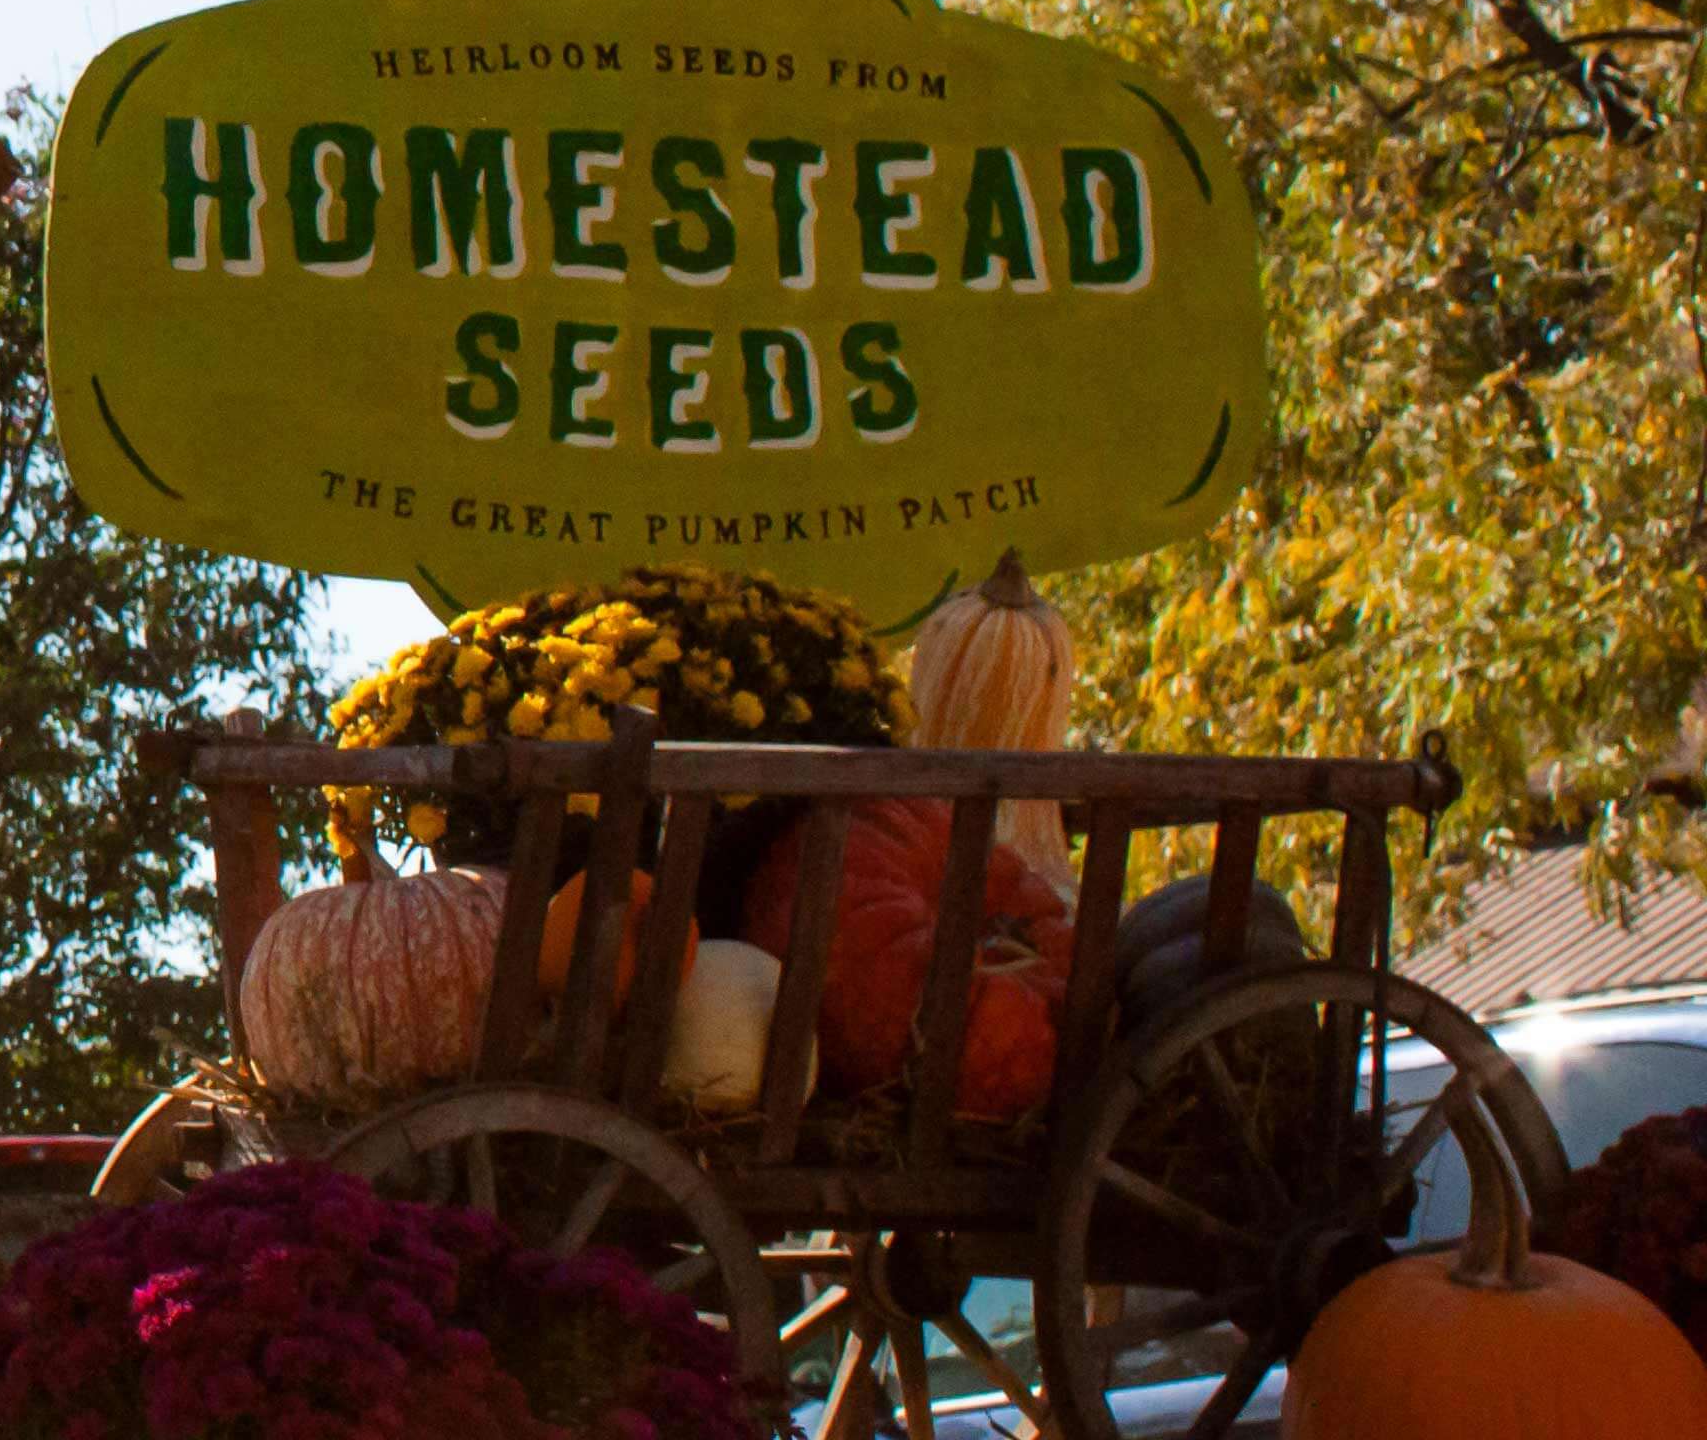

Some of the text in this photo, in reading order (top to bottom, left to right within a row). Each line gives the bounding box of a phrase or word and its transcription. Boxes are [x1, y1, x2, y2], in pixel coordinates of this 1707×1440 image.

[373, 44, 947, 99] HEIRLOOM SEEDS FROM
[160, 116, 1153, 294] HOMESTEAD
[444, 312, 921, 454] SEEDS
[320, 470, 1042, 546] THE GREAT PUMPKIN PATCH
